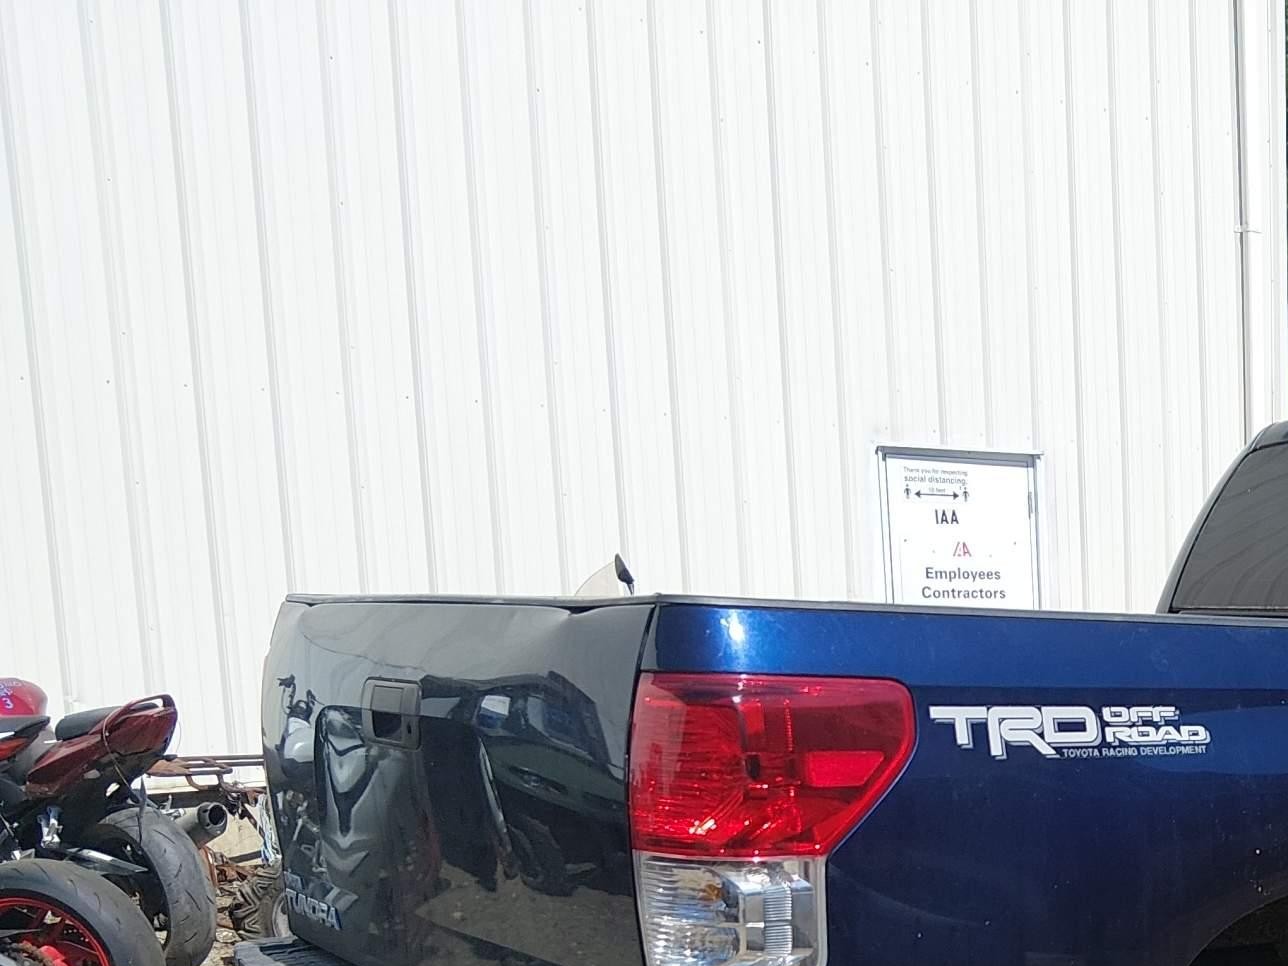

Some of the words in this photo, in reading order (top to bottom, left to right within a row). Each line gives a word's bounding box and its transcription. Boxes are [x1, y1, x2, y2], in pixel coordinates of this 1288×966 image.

[935, 509, 960, 525] IAA
[925, 567, 1001, 583] Employees
[921, 586, 1007, 600] Contractors
[1102, 706, 1180, 725] OFF
[928, 705, 1102, 760] TRD
[1104, 725, 1211, 746] ROAD
[1062, 748, 1100, 759] TOYOTA
[1102, 747, 1138, 758] RACING
[1140, 745, 1207, 757] DEVELOPMENT
[284, 887, 341, 931] TUNDRA
